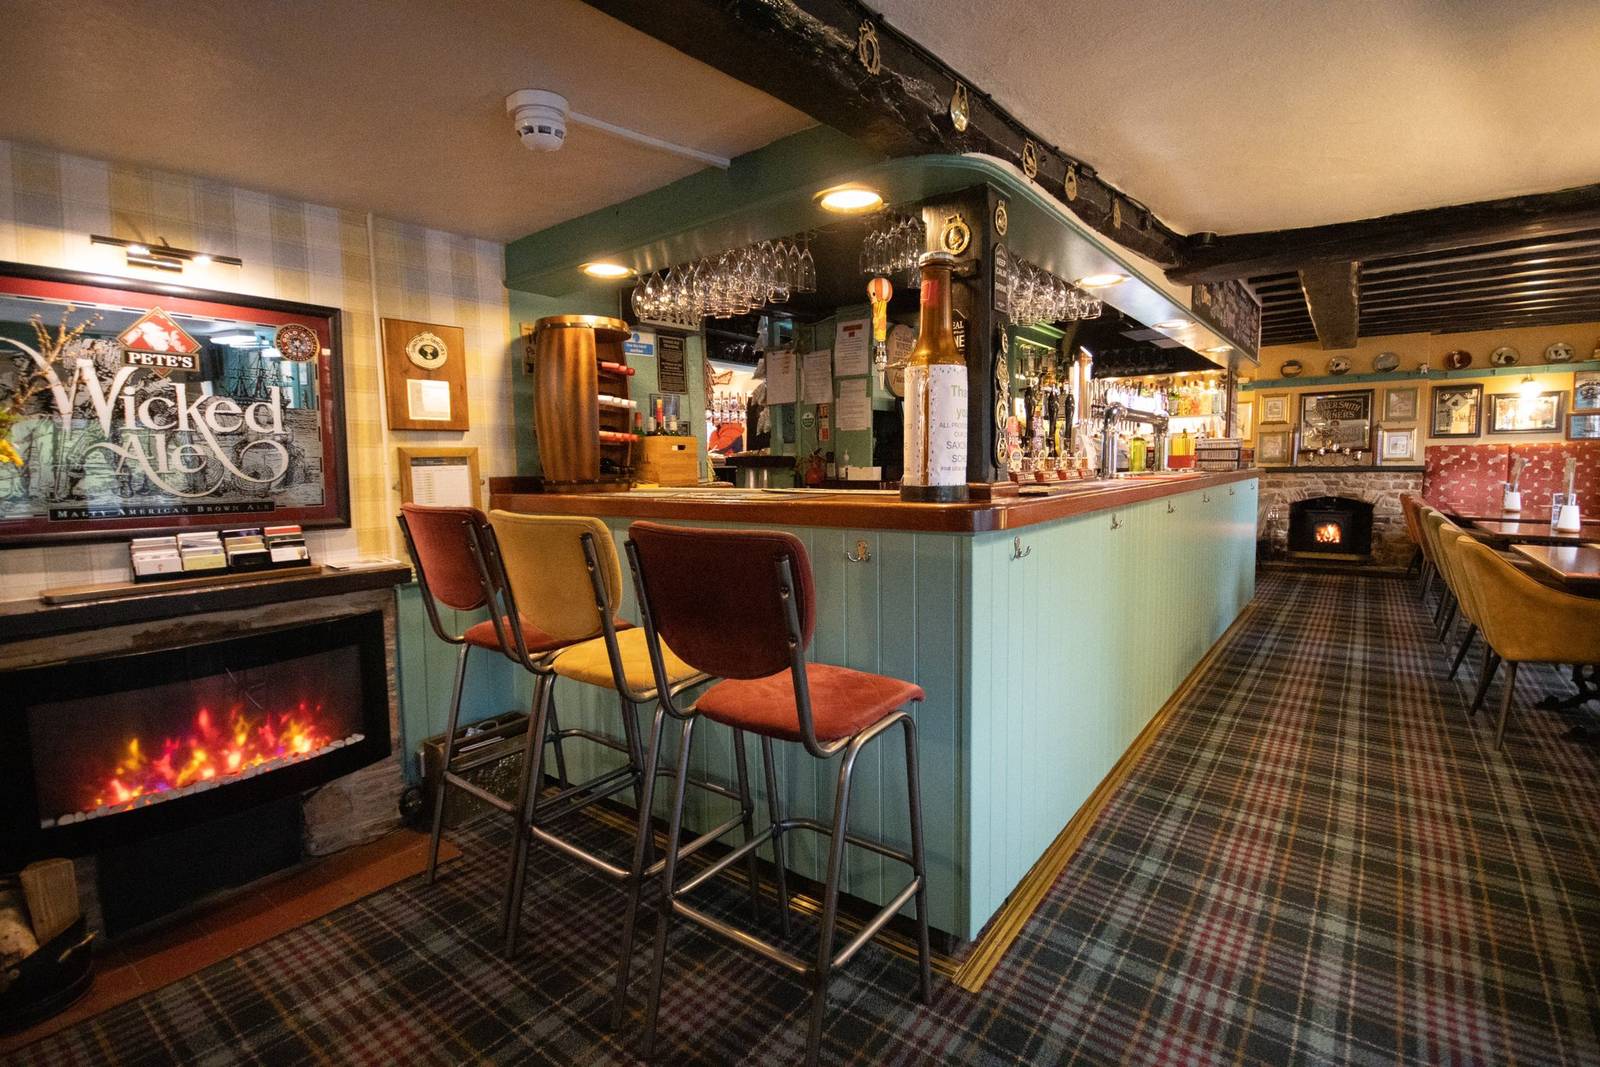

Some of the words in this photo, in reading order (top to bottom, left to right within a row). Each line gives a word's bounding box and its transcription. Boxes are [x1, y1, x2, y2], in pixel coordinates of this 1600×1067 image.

[127, 351, 193, 368] PETE'S
[79, 433, 225, 498] Ale
[119, 507, 188, 516] AMERICAN
[197, 505, 239, 513] BROWN
